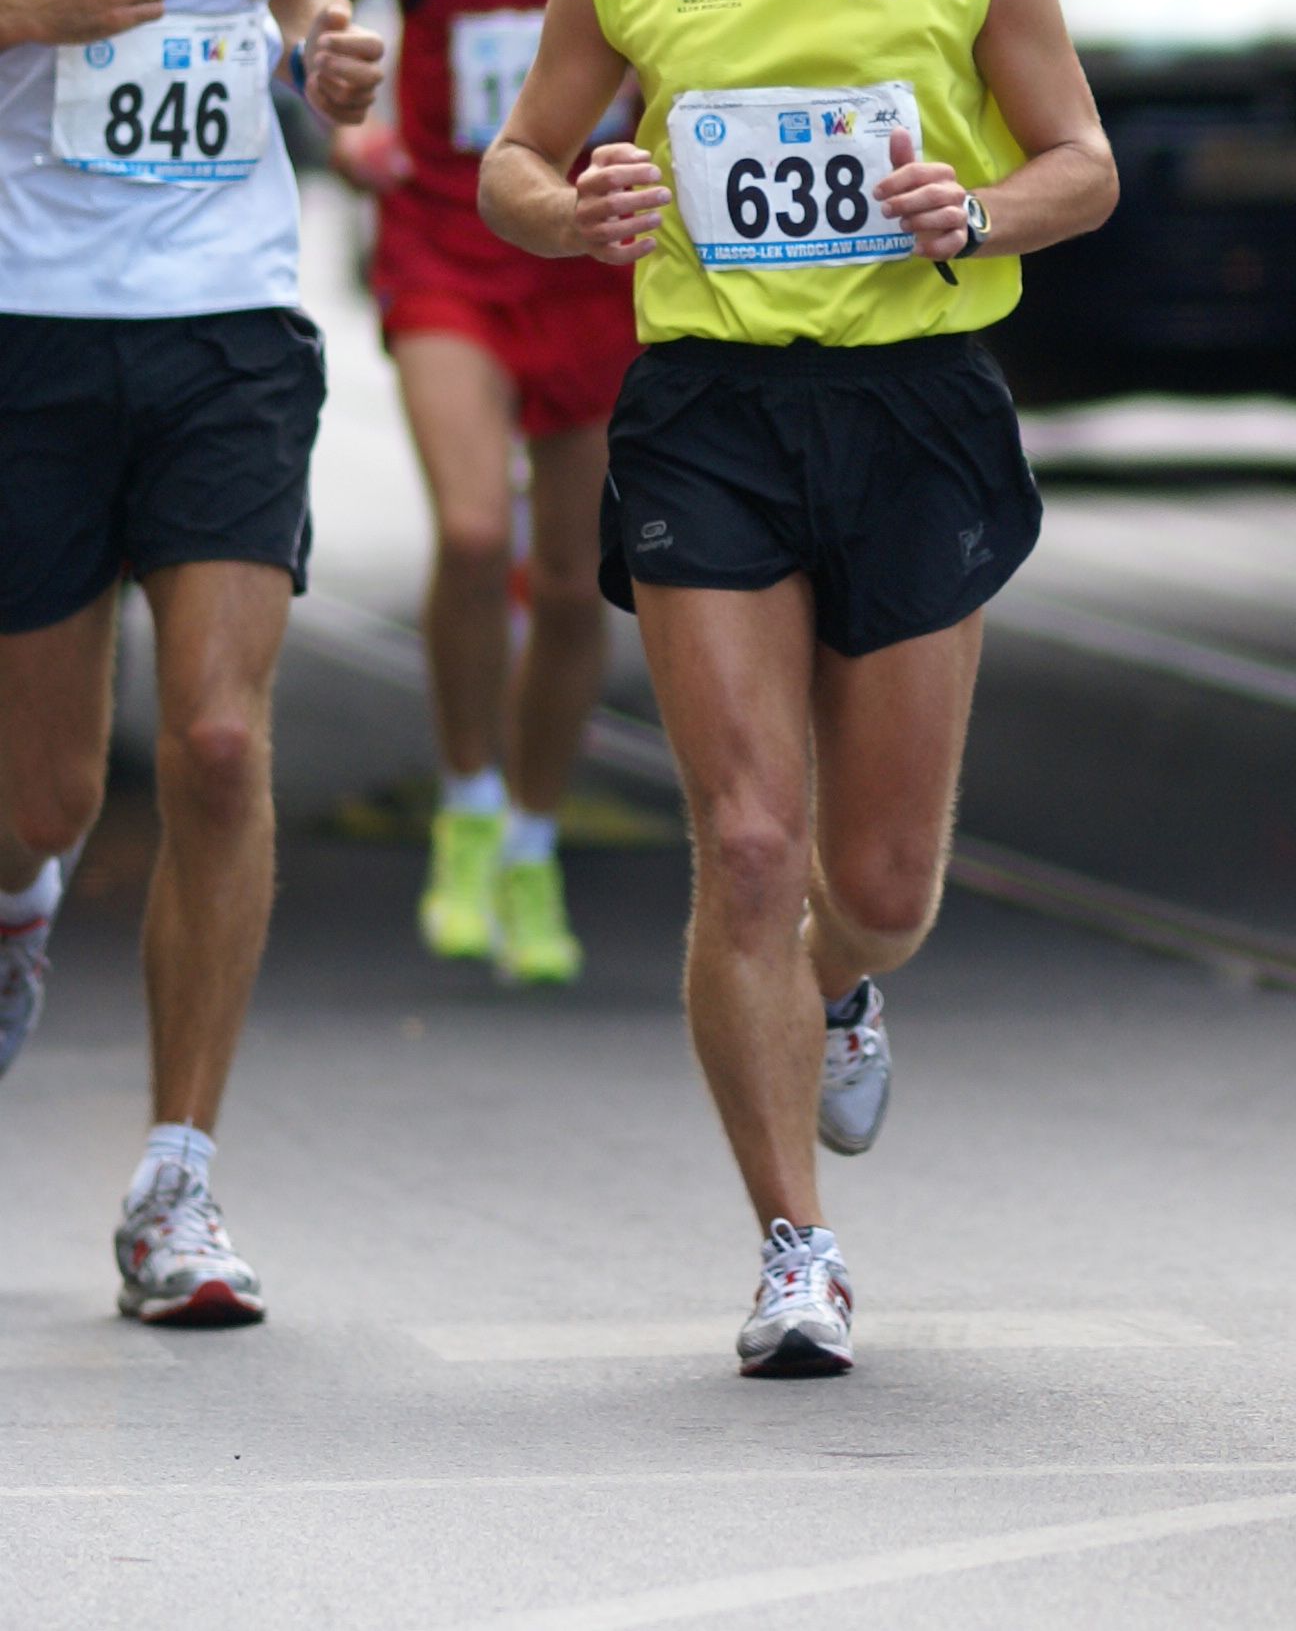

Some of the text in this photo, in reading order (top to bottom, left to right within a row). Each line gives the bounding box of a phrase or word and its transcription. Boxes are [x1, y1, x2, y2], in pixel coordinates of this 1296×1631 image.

[105, 81, 229, 159] 846
[726, 154, 869, 239] 638
[715, 244, 783, 260] HASCO-LEK
